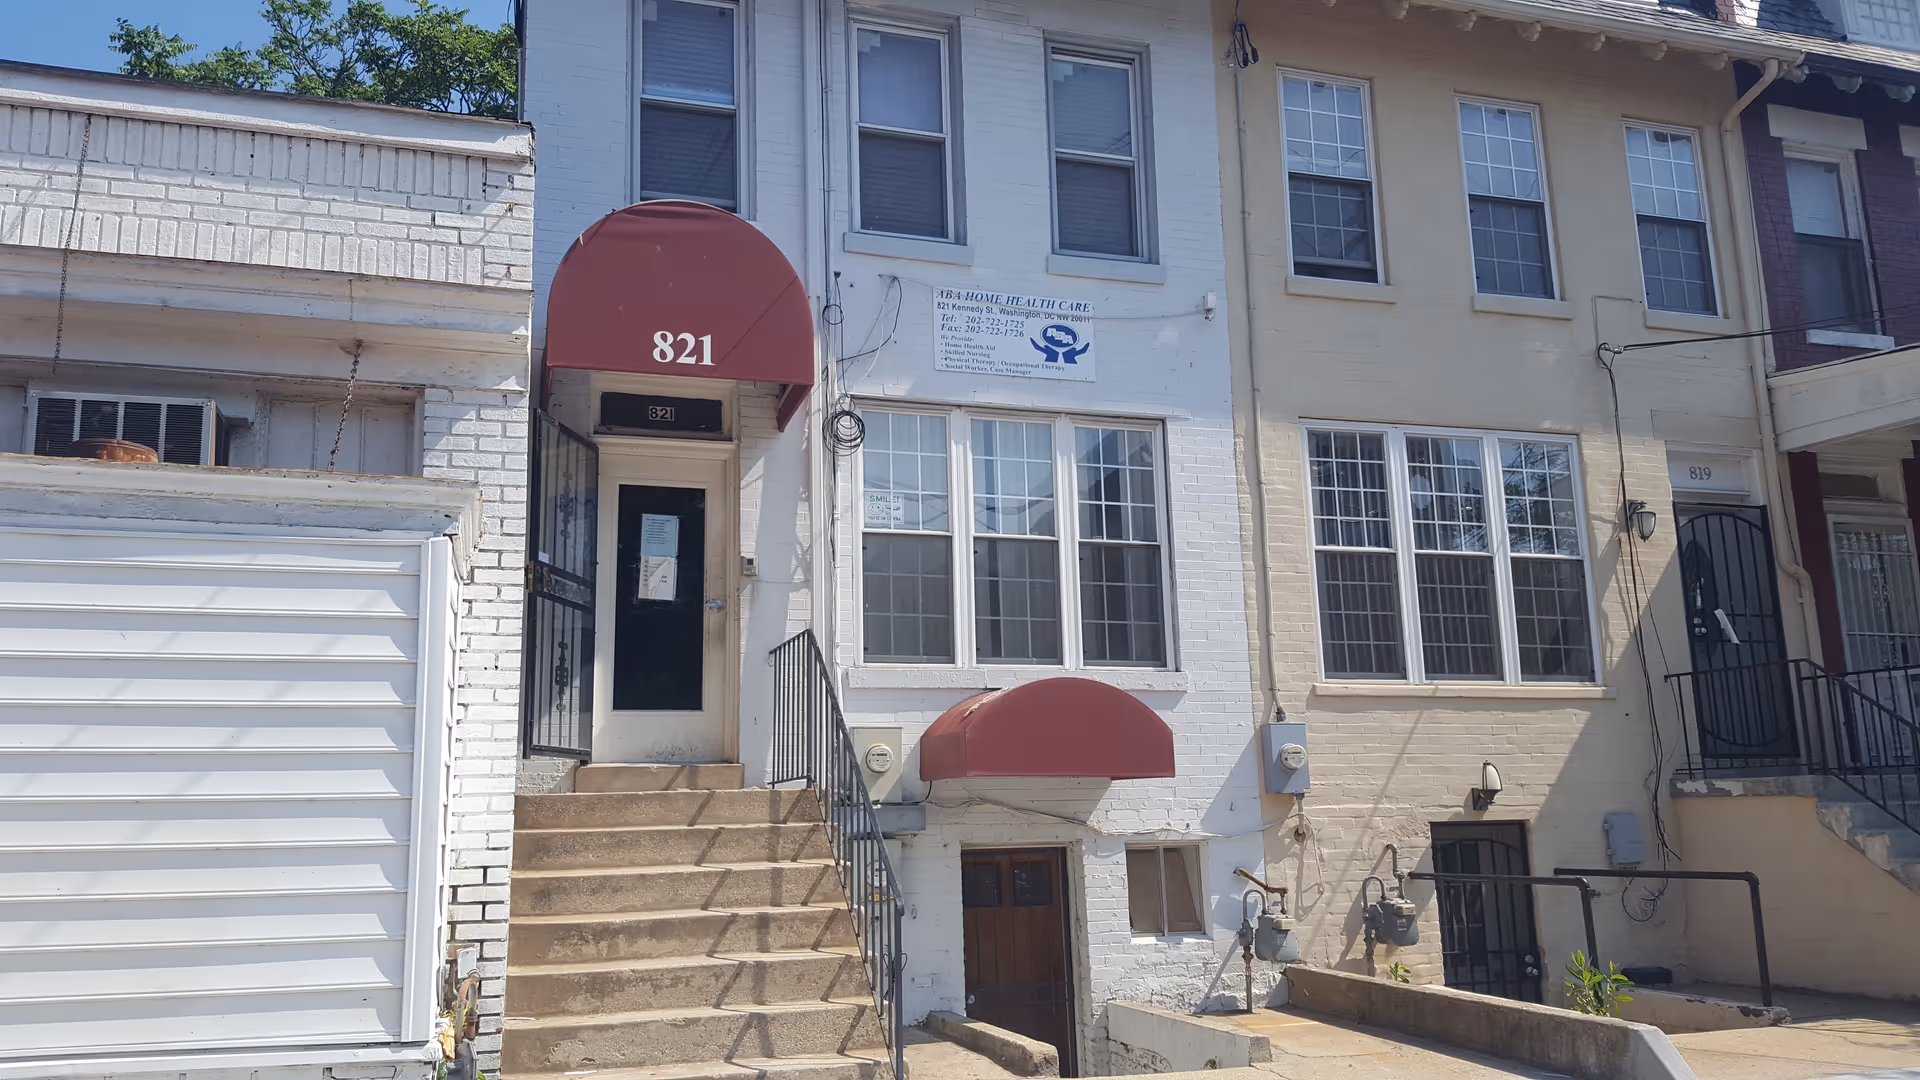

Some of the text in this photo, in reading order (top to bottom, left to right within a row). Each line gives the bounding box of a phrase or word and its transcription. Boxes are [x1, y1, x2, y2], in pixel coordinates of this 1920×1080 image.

[936, 290, 1091, 313] ABA HOME HEALTH CARE
[937, 302, 949, 310] 821
[952, 303, 983, 315] Kennedy
[999, 308, 1042, 320] Washington,
[1057, 313, 1069, 321] NW
[1071, 315, 1090, 323] 20011
[941, 314, 1025, 329] Tel: 202-722-1725
[941, 323, 1025, 338] Fax: 202-722-1726
[1047, 328, 1074, 344] ABA
[652, 330, 716, 366] 821
[967, 350, 991, 358] Nursing
[944, 356, 970, 364] Physical
[972, 358, 996, 366] Therapy
[1001, 360, 1040, 369] Occupational
[1042, 364, 1065, 372] Therapy
[650, 407, 674, 420] 821
[1689, 466, 1712, 480] 819
